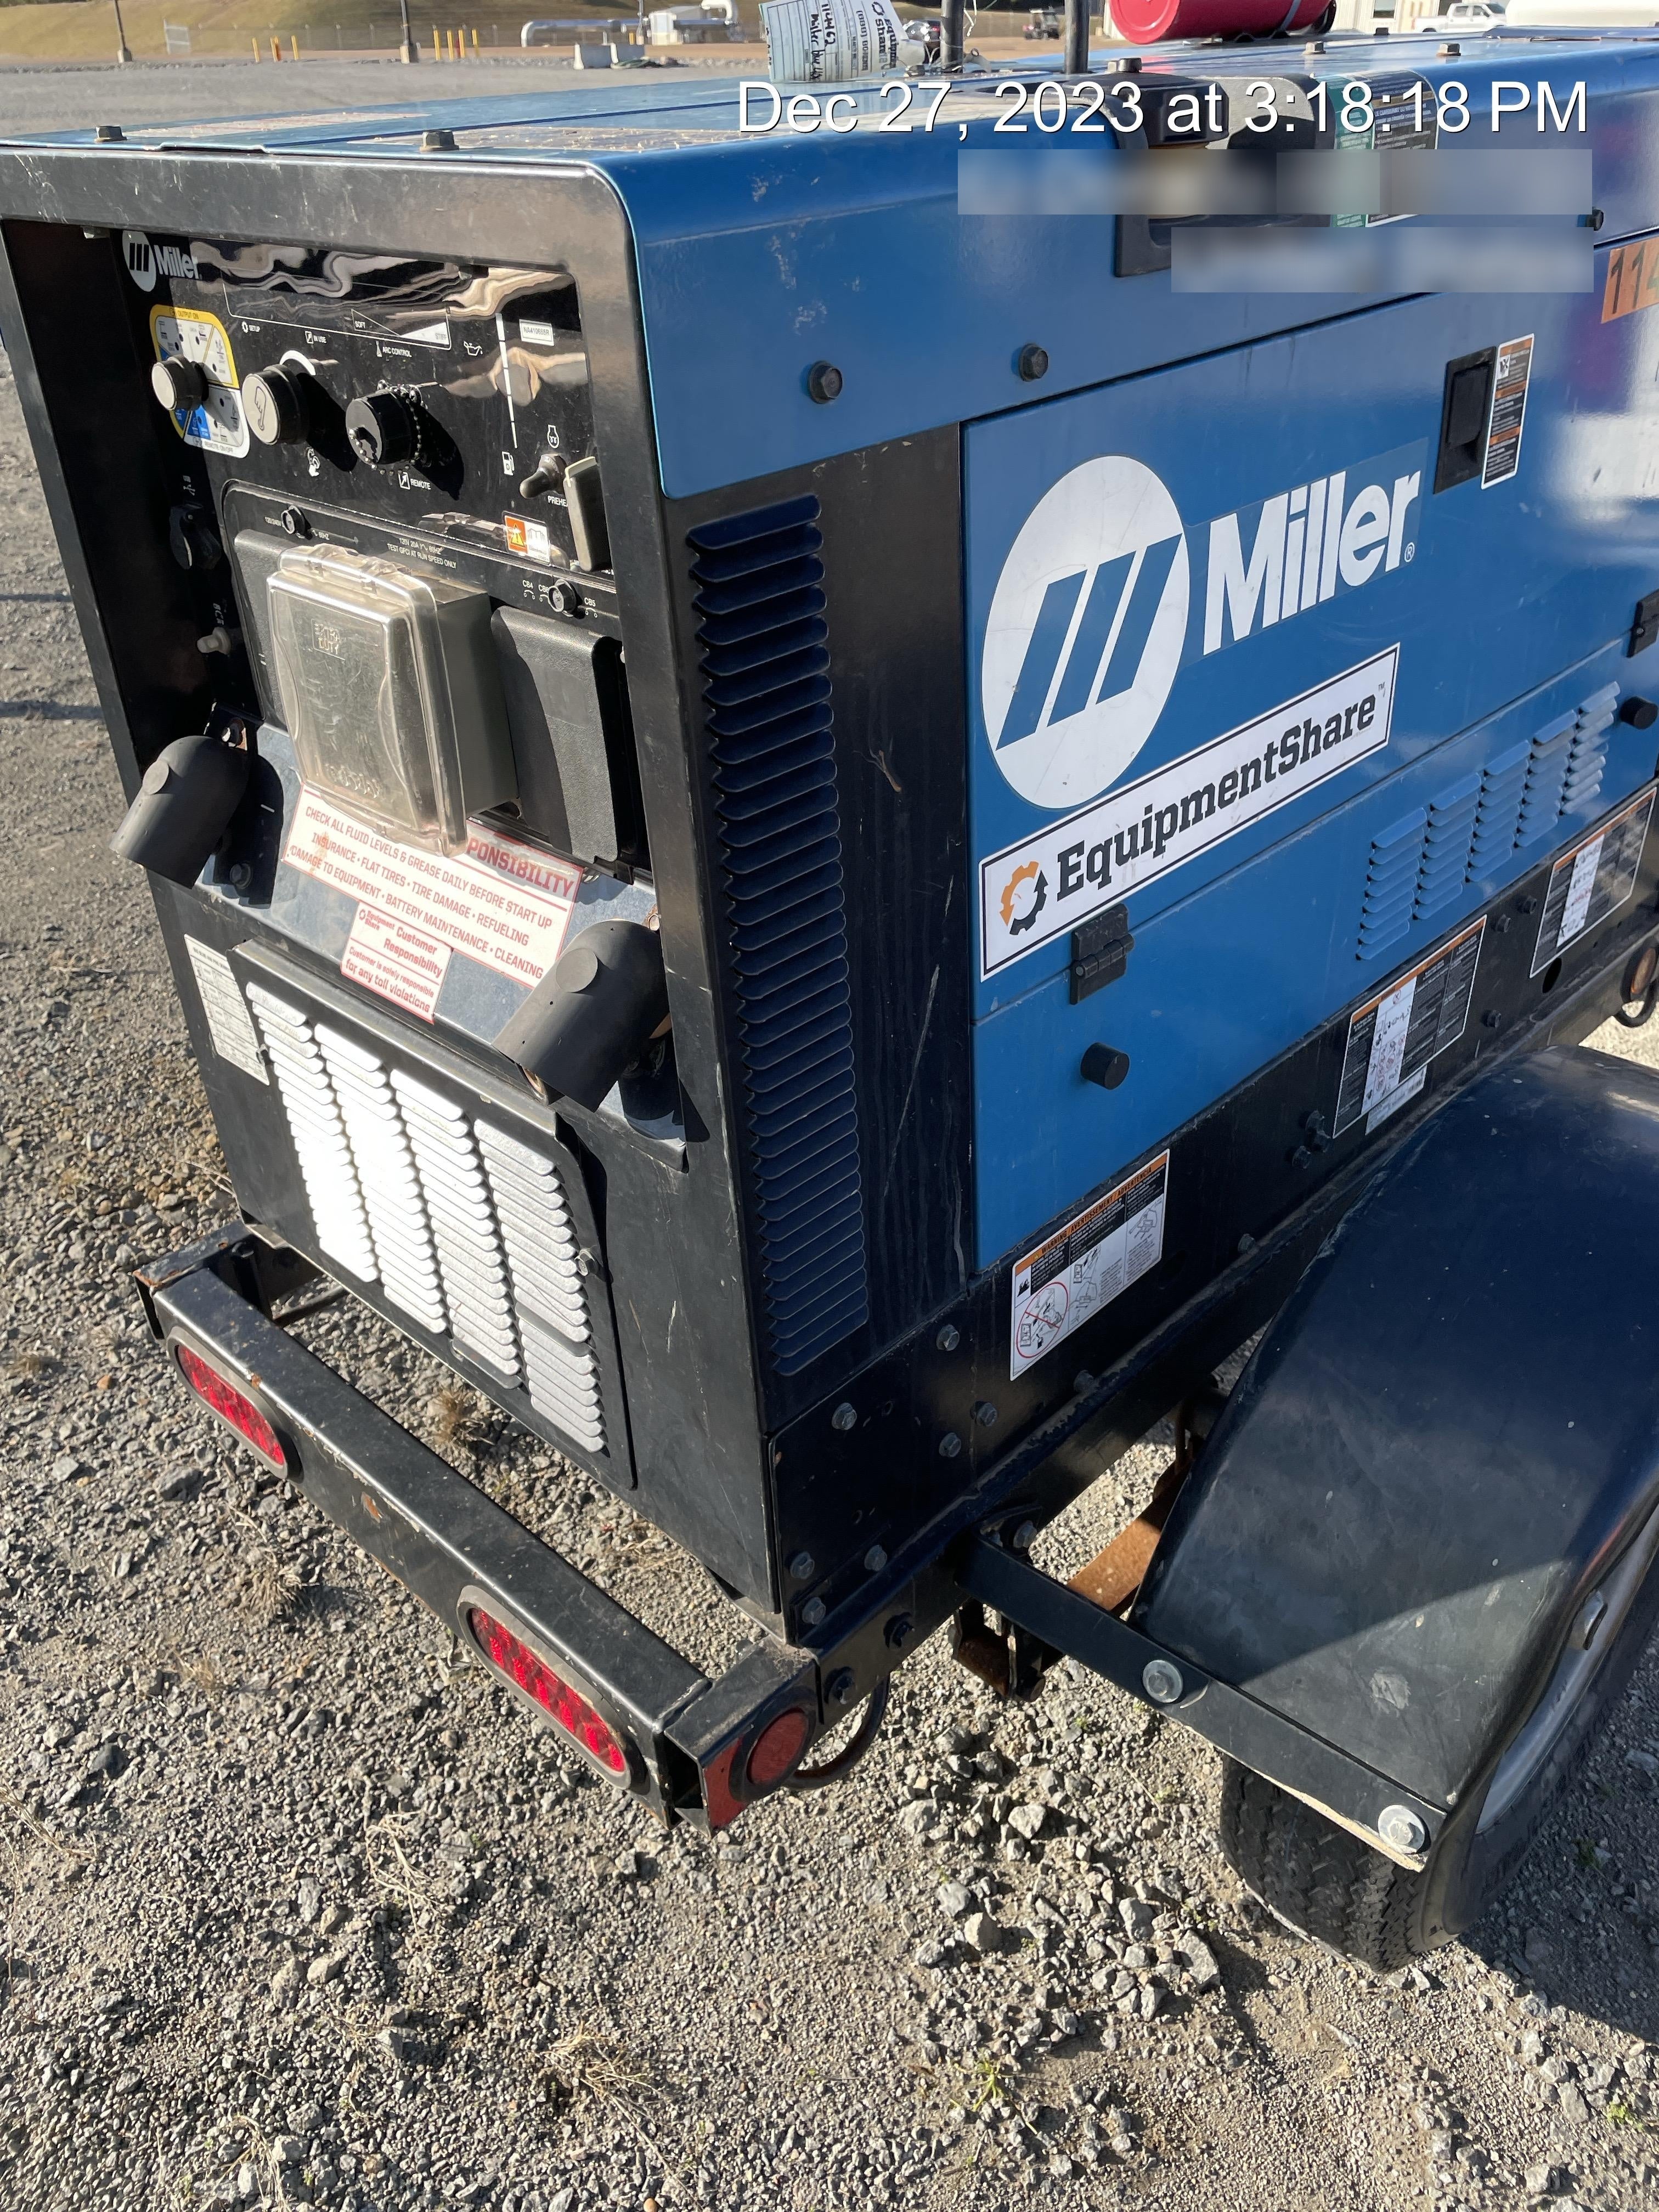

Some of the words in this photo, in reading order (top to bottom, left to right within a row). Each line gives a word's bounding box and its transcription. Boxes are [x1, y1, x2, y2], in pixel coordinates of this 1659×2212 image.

[154, 245, 199, 279] Miller
[354, 321, 365, 329] SOFT
[391, 348, 412, 357] CONTROL
[410, 478, 431, 490] REMOTE
[548, 495, 568, 507] PREHE
[387, 543, 399, 552] TEST
[417, 551, 428, 561] RUN
[428, 555, 444, 565] SPEED
[444, 559, 456, 569] ONLY
[1203, 470, 1421, 656] Miller
[522, 579, 533, 590] CB4
[584, 597, 596, 607] CB5
[1057, 693, 1376, 902] EquipmentShare
[306, 806, 329, 826] CHECK
[330, 817, 343, 834] ALL
[346, 825, 369, 844] FLUID
[370, 837, 399, 860] LEVELS
[400, 851, 407, 862] &
[407, 855, 441, 878] GREASE
[441, 871, 469, 891] DAILY
[469, 883, 505, 909] BEFORE
[505, 901, 537, 923] START
[537, 915, 552, 930] UP
[466, 836, 574, 898] PONSIBILITY
[312, 832, 356, 862] INSURANCE
[360, 857, 381, 873] FLAT
[382, 866, 406, 887] TIRES
[412, 881, 431, 900] TIRE
[432, 892, 471, 918] DAMAGE
[476, 912, 529, 946] REFUELING
[290, 845, 321, 869] DAMAGE
[323, 861, 334, 874] TO
[334, 867, 381, 899] EQUIPMENT
[385, 894, 423, 919] BATTERY
[423, 912, 489, 953] MAINTENANCE
[495, 947, 544, 979] CLEANING
[365, 918, 380, 931] Share
[367, 910, 396, 930] Equipment
[397, 926, 437, 955] Customer
[349, 946, 376, 967] Customer
[377, 961, 382, 970] is
[382, 964, 400, 981] solely
[400, 975, 434, 998] responsible
[384, 938, 442, 978] Responsibility
[346, 958, 358, 974] for
[358, 968, 373, 984] any
[375, 974, 388, 990] toll
[390, 984, 430, 1013] violations
[1042, 1230, 1068, 1254] WARNING
